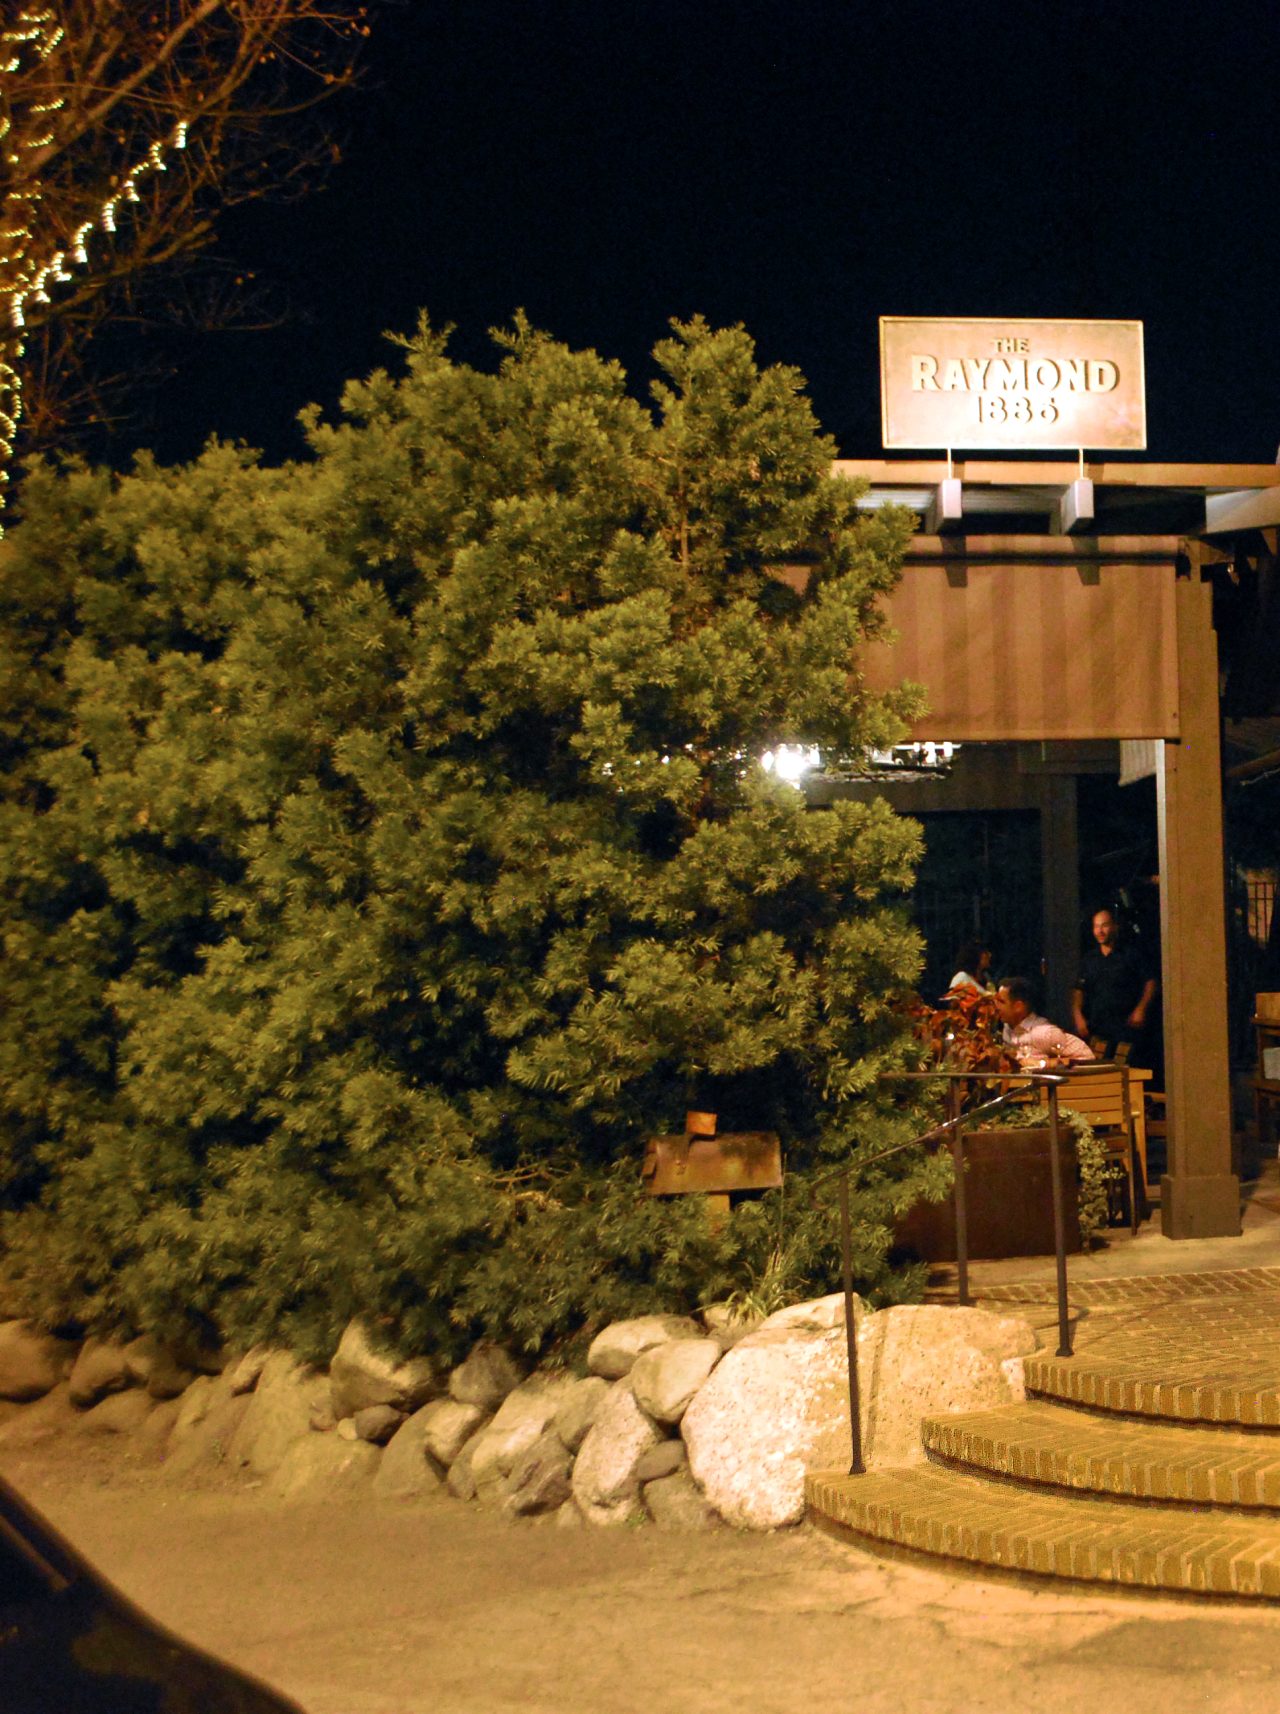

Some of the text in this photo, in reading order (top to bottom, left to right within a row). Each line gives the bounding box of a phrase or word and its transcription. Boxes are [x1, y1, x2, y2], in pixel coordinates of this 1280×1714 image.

[993, 337, 1029, 352] THE
[911, 355, 1120, 392] RAYMOND
[974, 396, 1059, 423] 1886
